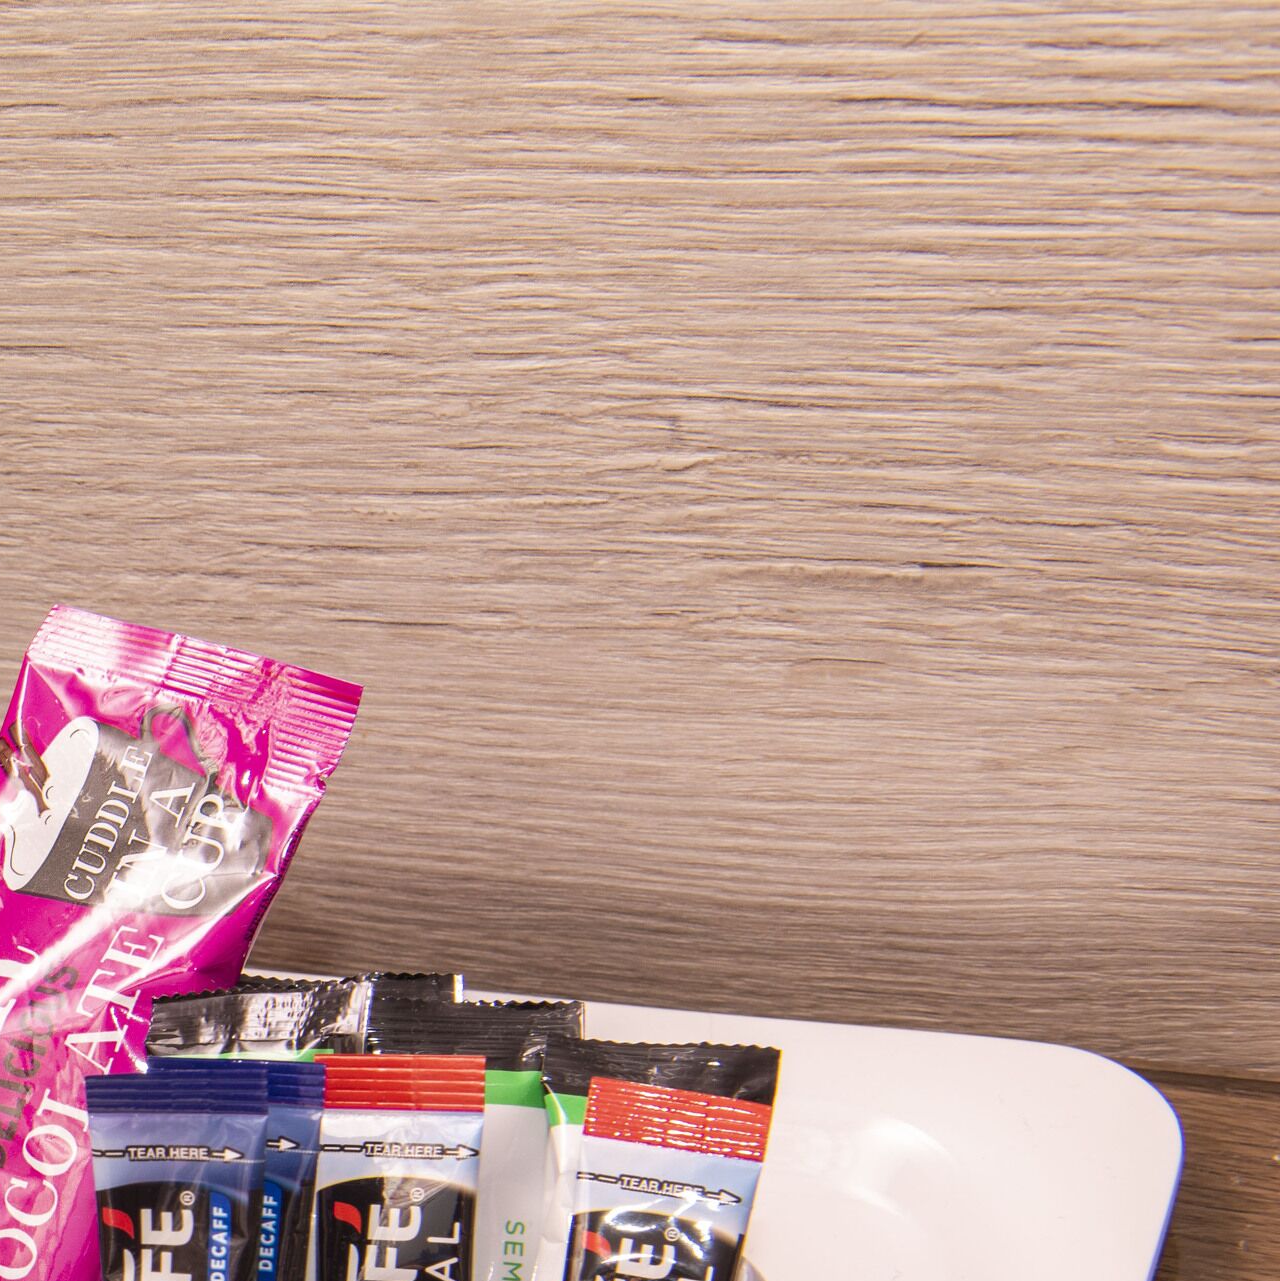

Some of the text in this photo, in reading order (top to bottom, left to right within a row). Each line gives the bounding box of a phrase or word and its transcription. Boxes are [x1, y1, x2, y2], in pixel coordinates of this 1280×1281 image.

[63, 745, 153, 901] CUDDLE
[149, 782, 196, 829] A
[160, 793, 248, 909] CUP
[128, 1147, 209, 1161] TEAR HERE
[366, 1143, 443, 1159] TEAR HERE
[620, 1174, 658, 1194] TEAR
[258, 1195, 278, 1272] DECAFF
